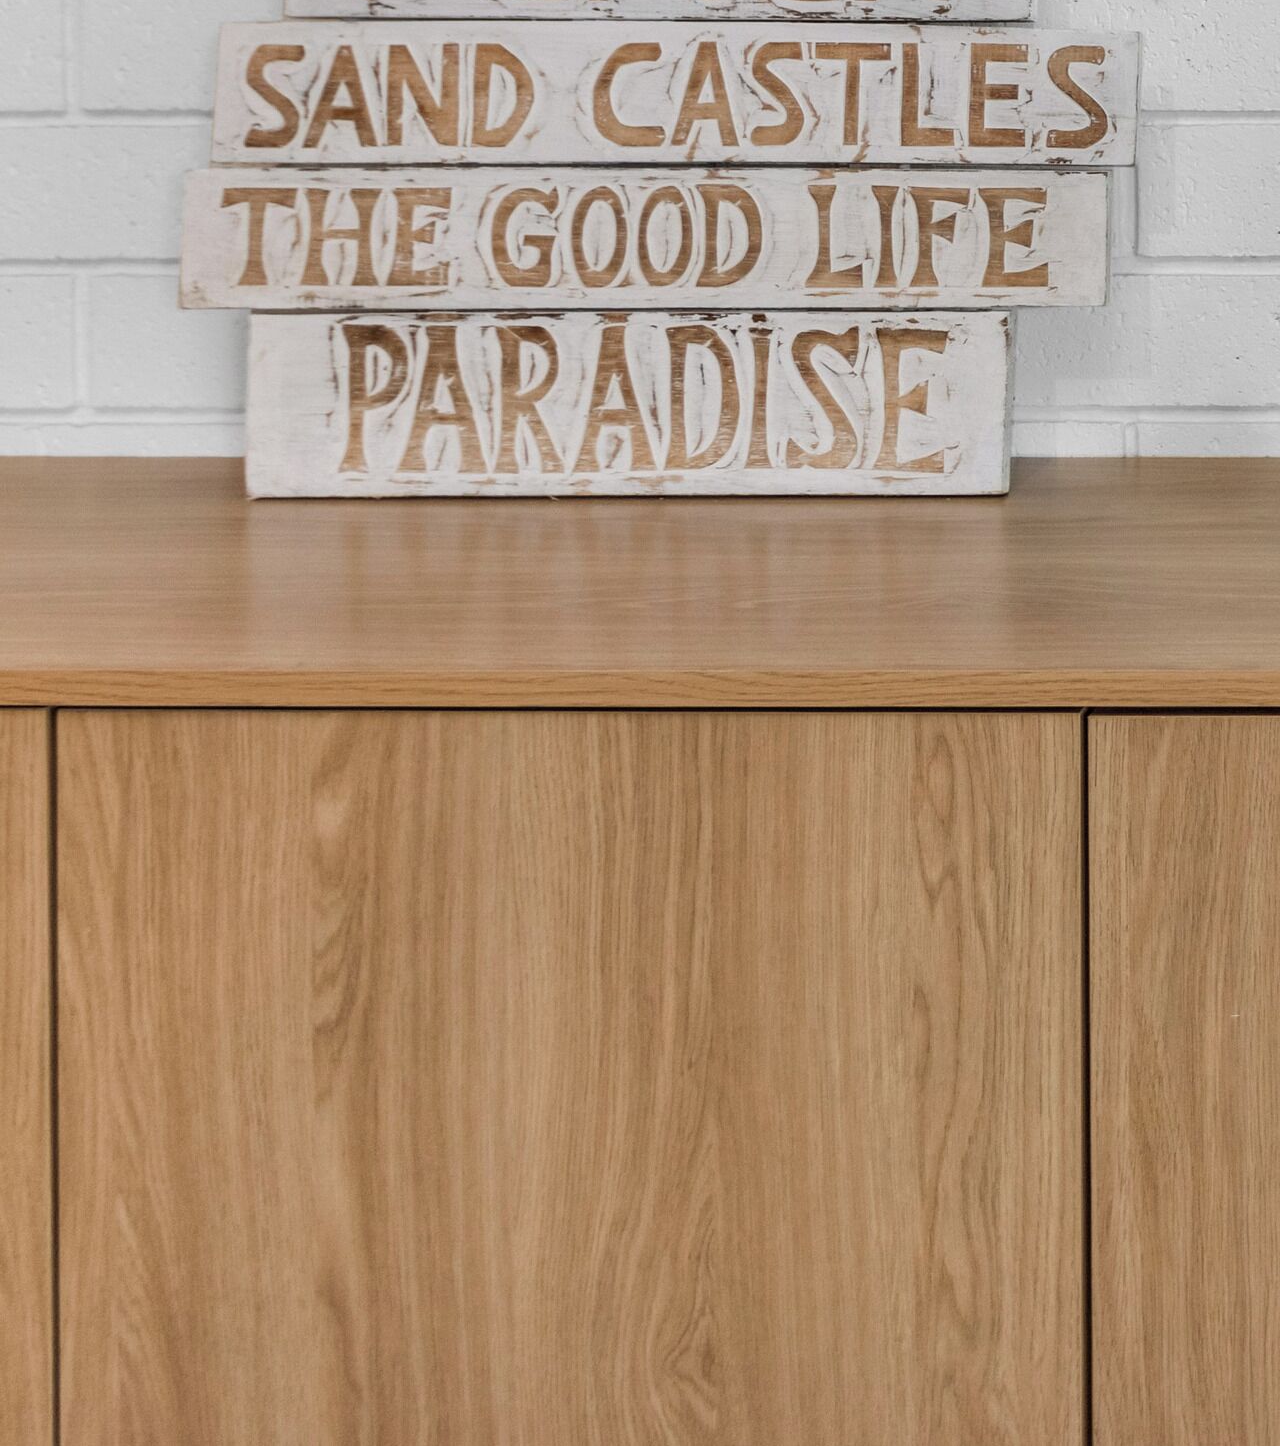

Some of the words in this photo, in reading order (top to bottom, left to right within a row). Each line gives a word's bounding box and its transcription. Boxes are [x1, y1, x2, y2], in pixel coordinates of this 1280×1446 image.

[244, 44, 535, 148] SAND
[593, 42, 1109, 149] CASTLES
[221, 187, 453, 287] THE
[489, 184, 763, 288] GOOD
[804, 185, 1052, 288] LIFE
[337, 324, 950, 474] PARADISE
